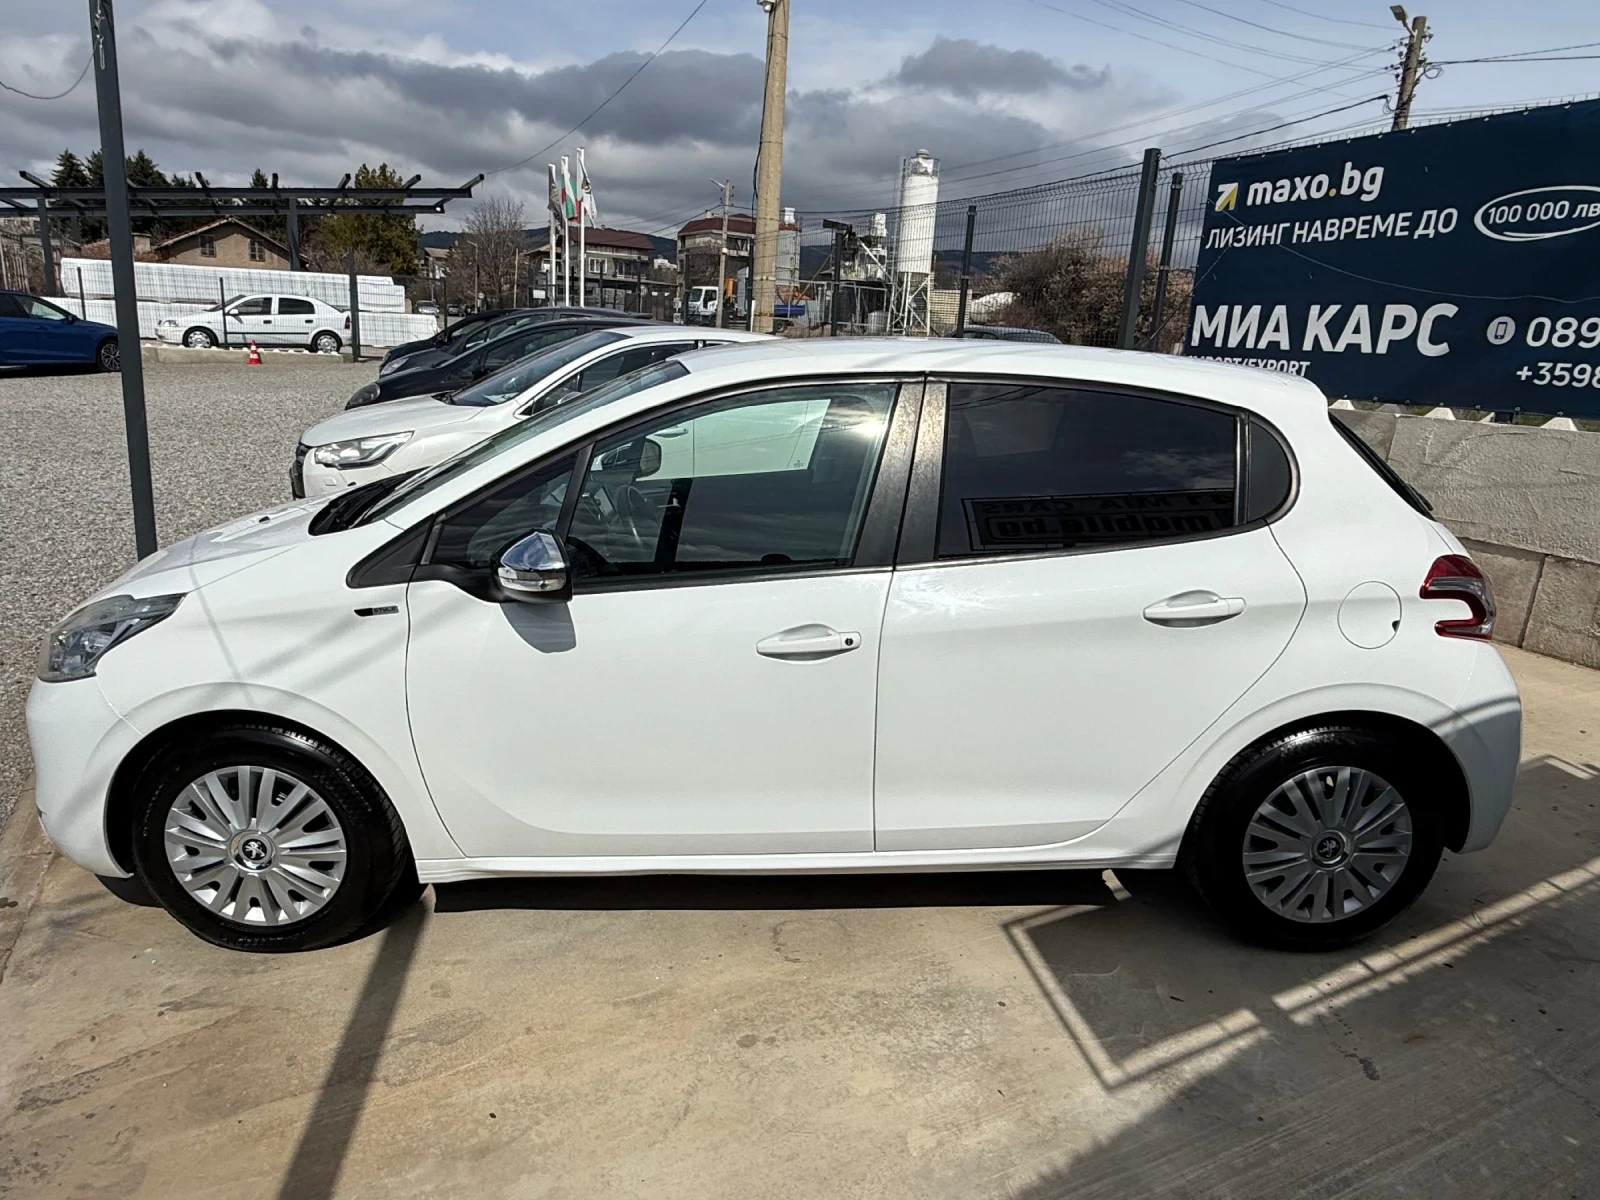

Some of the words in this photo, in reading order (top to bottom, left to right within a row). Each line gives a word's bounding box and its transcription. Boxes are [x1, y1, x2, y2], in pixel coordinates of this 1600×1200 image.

[1246, 161, 1385, 206] maxo.bg
[1205, 222, 1291, 249] ЛИЗИНГ
[1292, 211, 1413, 244] НАВРЕМЕ
[1413, 207, 1458, 239] ДО
[1488, 204, 1523, 224] 100
[1526, 200, 1570, 222] 000
[1190, 304, 1291, 351] МИА
[1302, 303, 1459, 356] КАРС
[1526, 316, 1600, 349] 089
